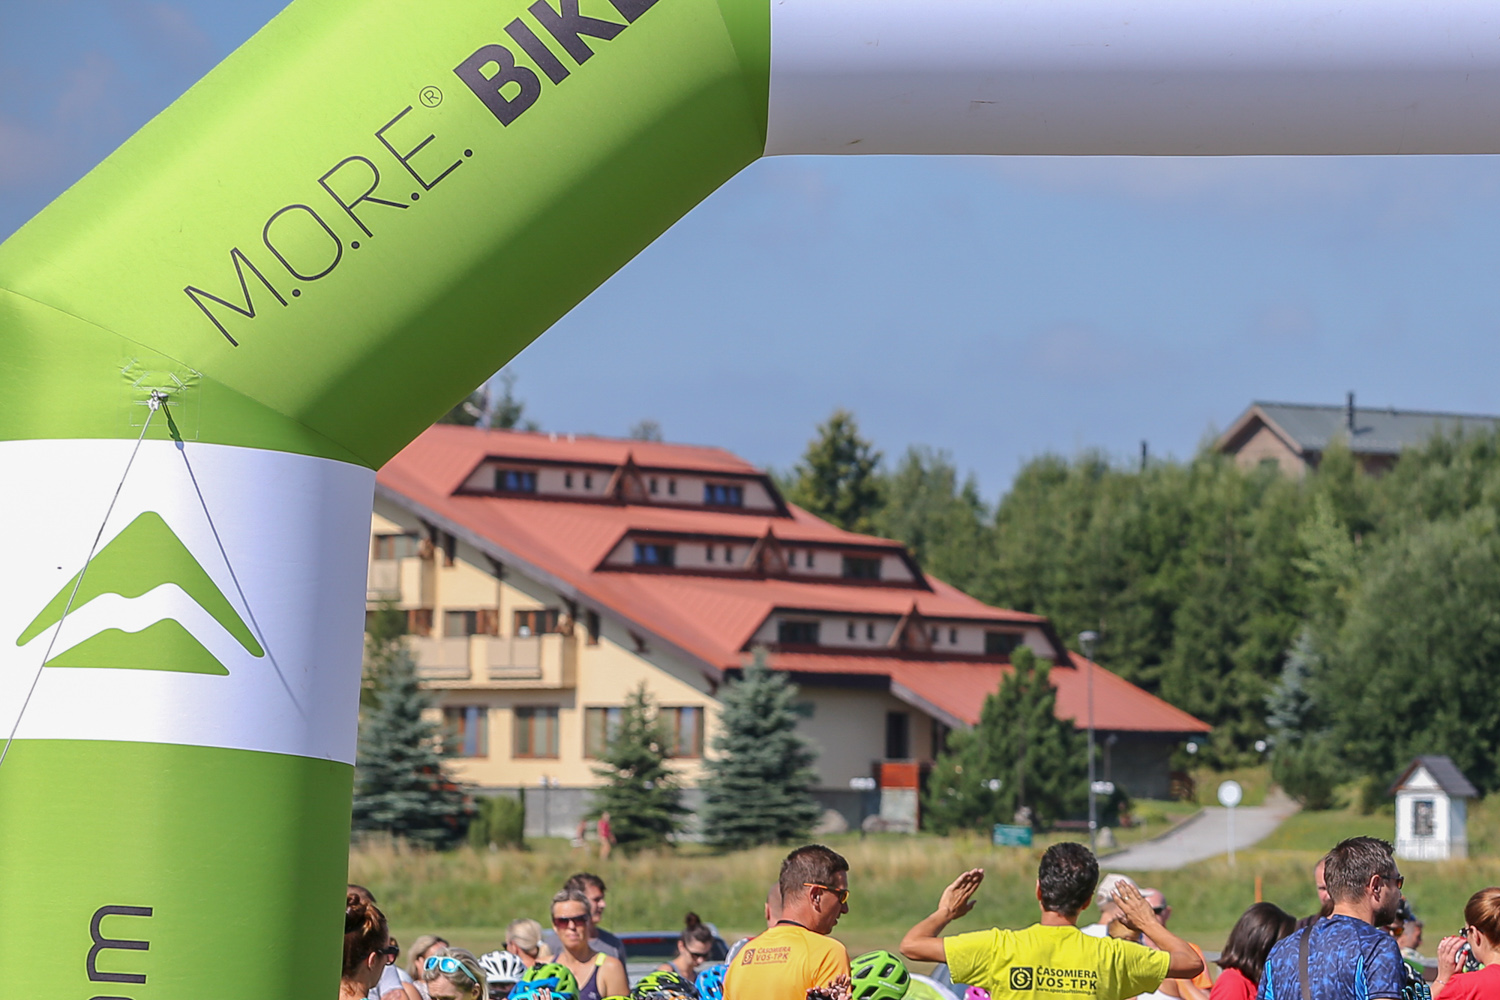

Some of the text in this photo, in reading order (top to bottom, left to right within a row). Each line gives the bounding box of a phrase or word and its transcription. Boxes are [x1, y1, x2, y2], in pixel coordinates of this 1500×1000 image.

[453, 0, 661, 127] BIK
[1036, 965, 1098, 979] ČASOMIERA
[1036, 977, 1098, 990] VOS-TPK
